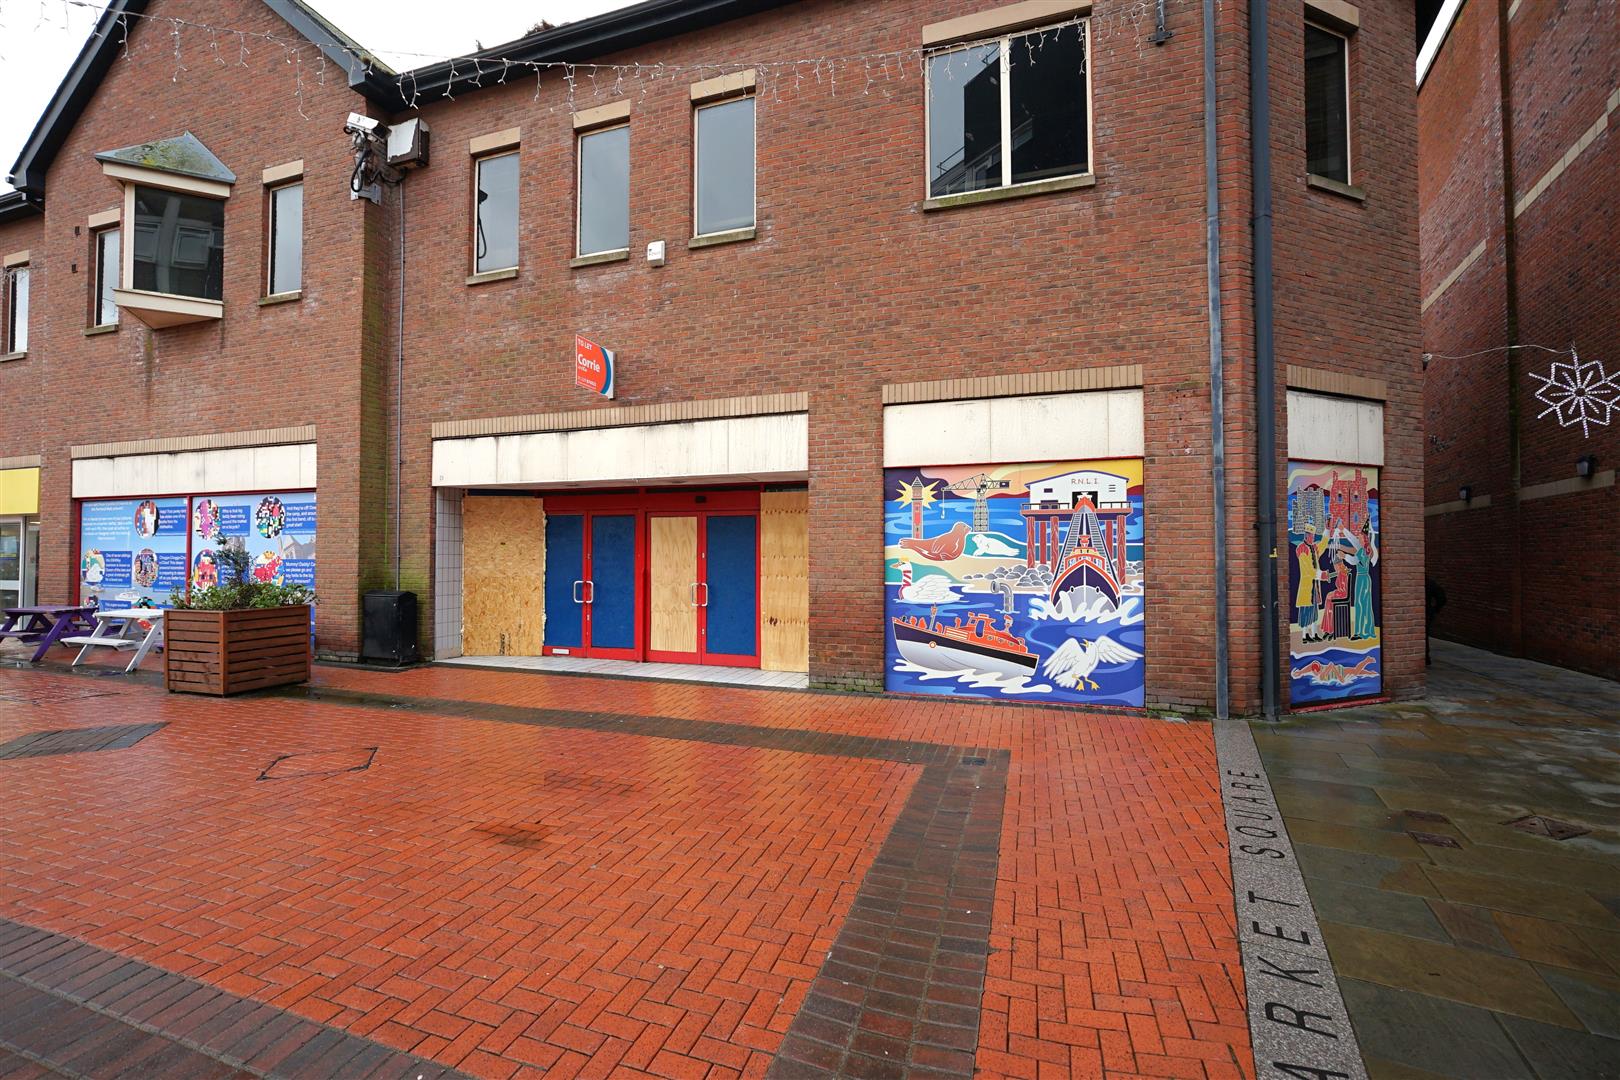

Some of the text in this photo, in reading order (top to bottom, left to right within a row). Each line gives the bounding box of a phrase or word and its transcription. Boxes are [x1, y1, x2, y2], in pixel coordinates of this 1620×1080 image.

[578, 338, 593, 351] TO LET
[578, 353, 601, 373] Corrie
[1227, 769, 1285, 860] SQUARE
